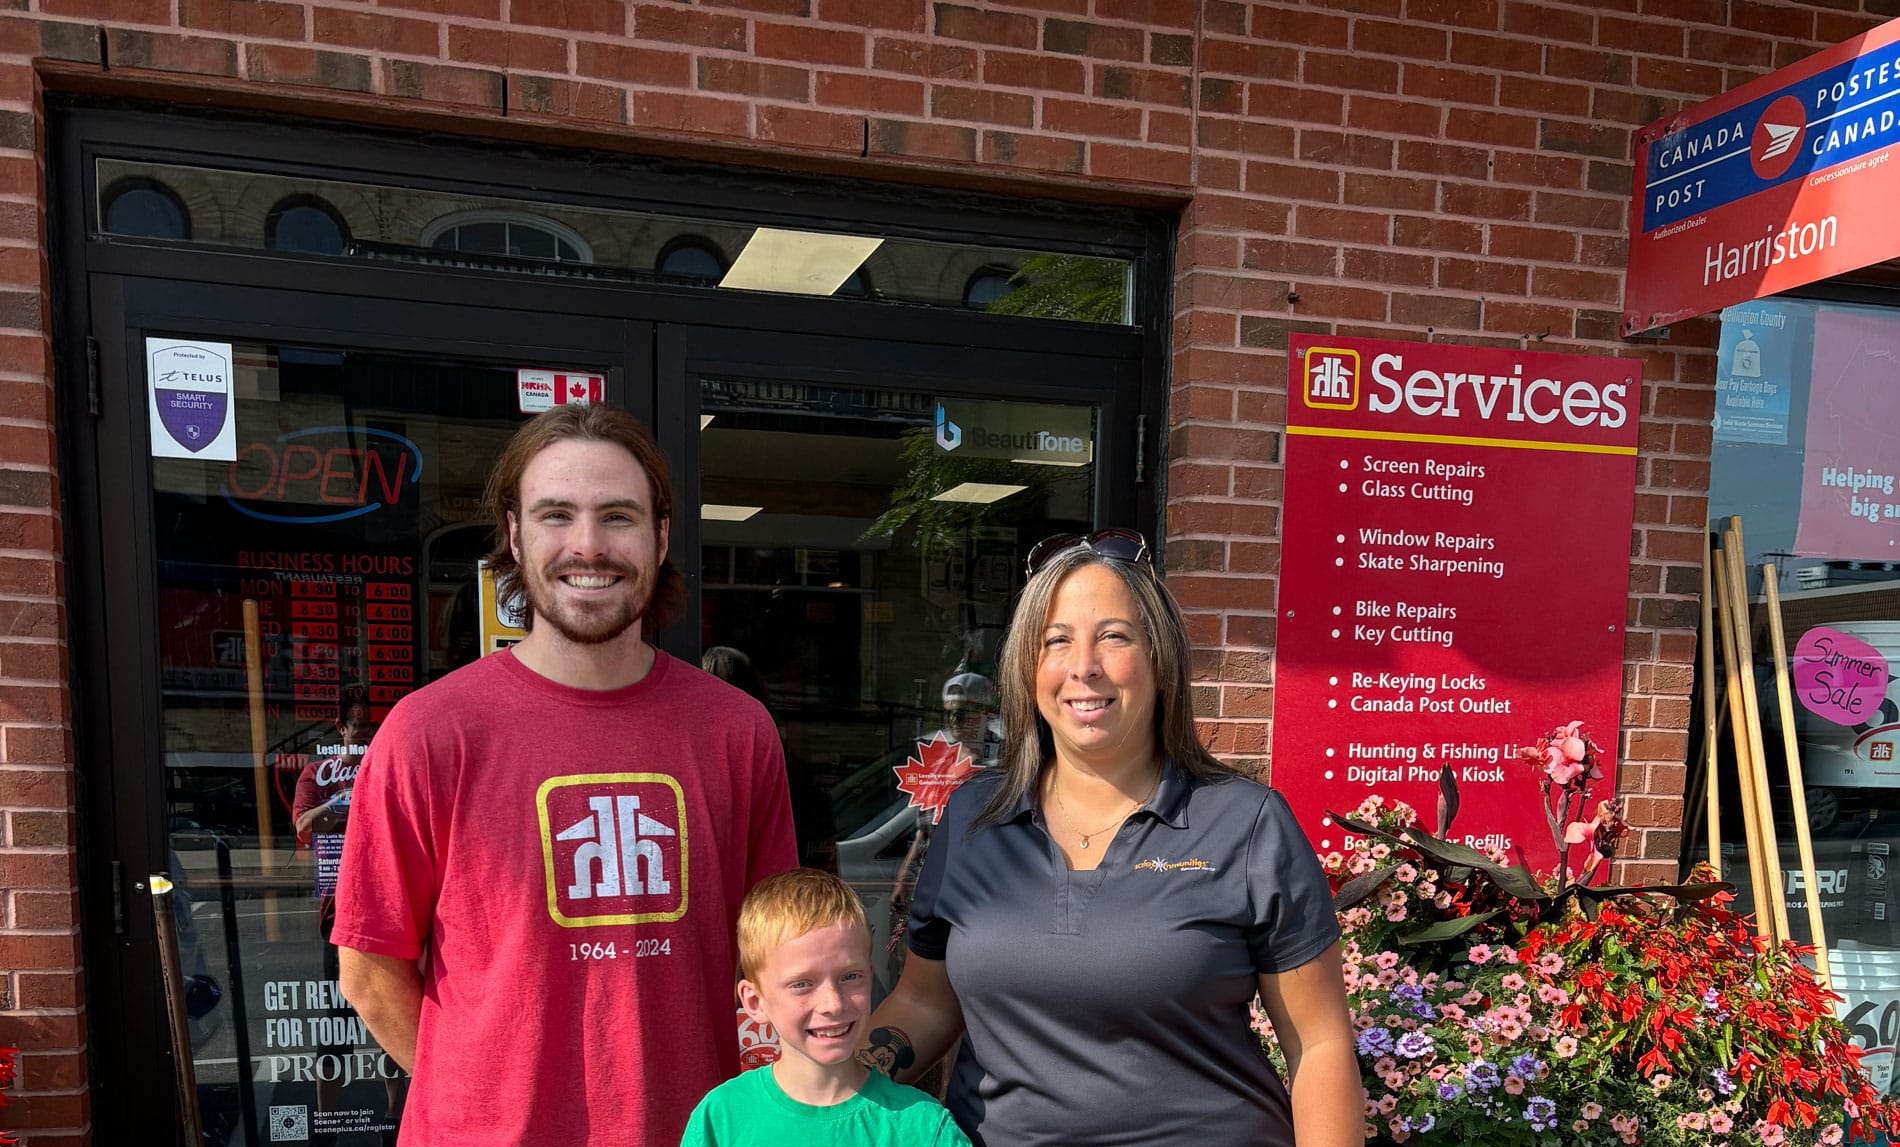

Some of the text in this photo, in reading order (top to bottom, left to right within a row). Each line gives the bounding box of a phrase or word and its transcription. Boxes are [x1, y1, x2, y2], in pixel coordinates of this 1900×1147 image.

[1659, 121, 1744, 169] CANADA
[1812, 109, 1900, 156] CANAD
[1809, 151, 1889, 187] Concessionnaire agréé
[1655, 179, 1706, 213] POST
[1653, 215, 1707, 241] Authorized Dealer
[1703, 214, 1837, 287] Harriston
[182, 372, 223, 383] TELUS
[176, 392, 207, 401] SMART
[1368, 353, 1627, 429] Services
[170, 400, 214, 410] SECURITY
[229, 444, 407, 505] OPEN
[1363, 455, 1486, 480] Screen Repairs
[1362, 480, 1474, 506] Glass Cutting
[1822, 467, 1894, 494] Helping
[1850, 496, 1879, 522] big
[1359, 528, 1495, 553] Window Repairs
[237, 550, 414, 576] BUSINESS HOURS
[1358, 553, 1504, 579] Skate Sharpening
[241, 577, 284, 595] MON
[1355, 601, 1457, 623] Bike Repairs
[260, 621, 281, 637] ED
[1354, 625, 1453, 647] Key Cutting
[1803, 637, 1882, 679] Summer
[1351, 673, 1486, 693] Re-Keying Locks
[1808, 671, 1863, 715] Sale
[1350, 696, 1511, 714] Canada Post Outlet
[316, 743, 348, 755] Leslie
[1348, 744, 1417, 763] Hunting
[1422, 744, 1436, 760] &
[1441, 744, 1499, 764] Fishing
[1347, 766, 1505, 787] Digital Pho Kiosk
[1464, 834, 1512, 851] Refills
[569, 941, 617, 961] 1964
[635, 938, 672, 958] 2024
[264, 980, 352, 1011] GET REW
[266, 1016, 368, 1048] FOR TODAY
[268, 1053, 411, 1088] PROJEC
[359, 1108, 374, 1117] join
[314, 1124, 396, 1134] sceneplus.ca/register
